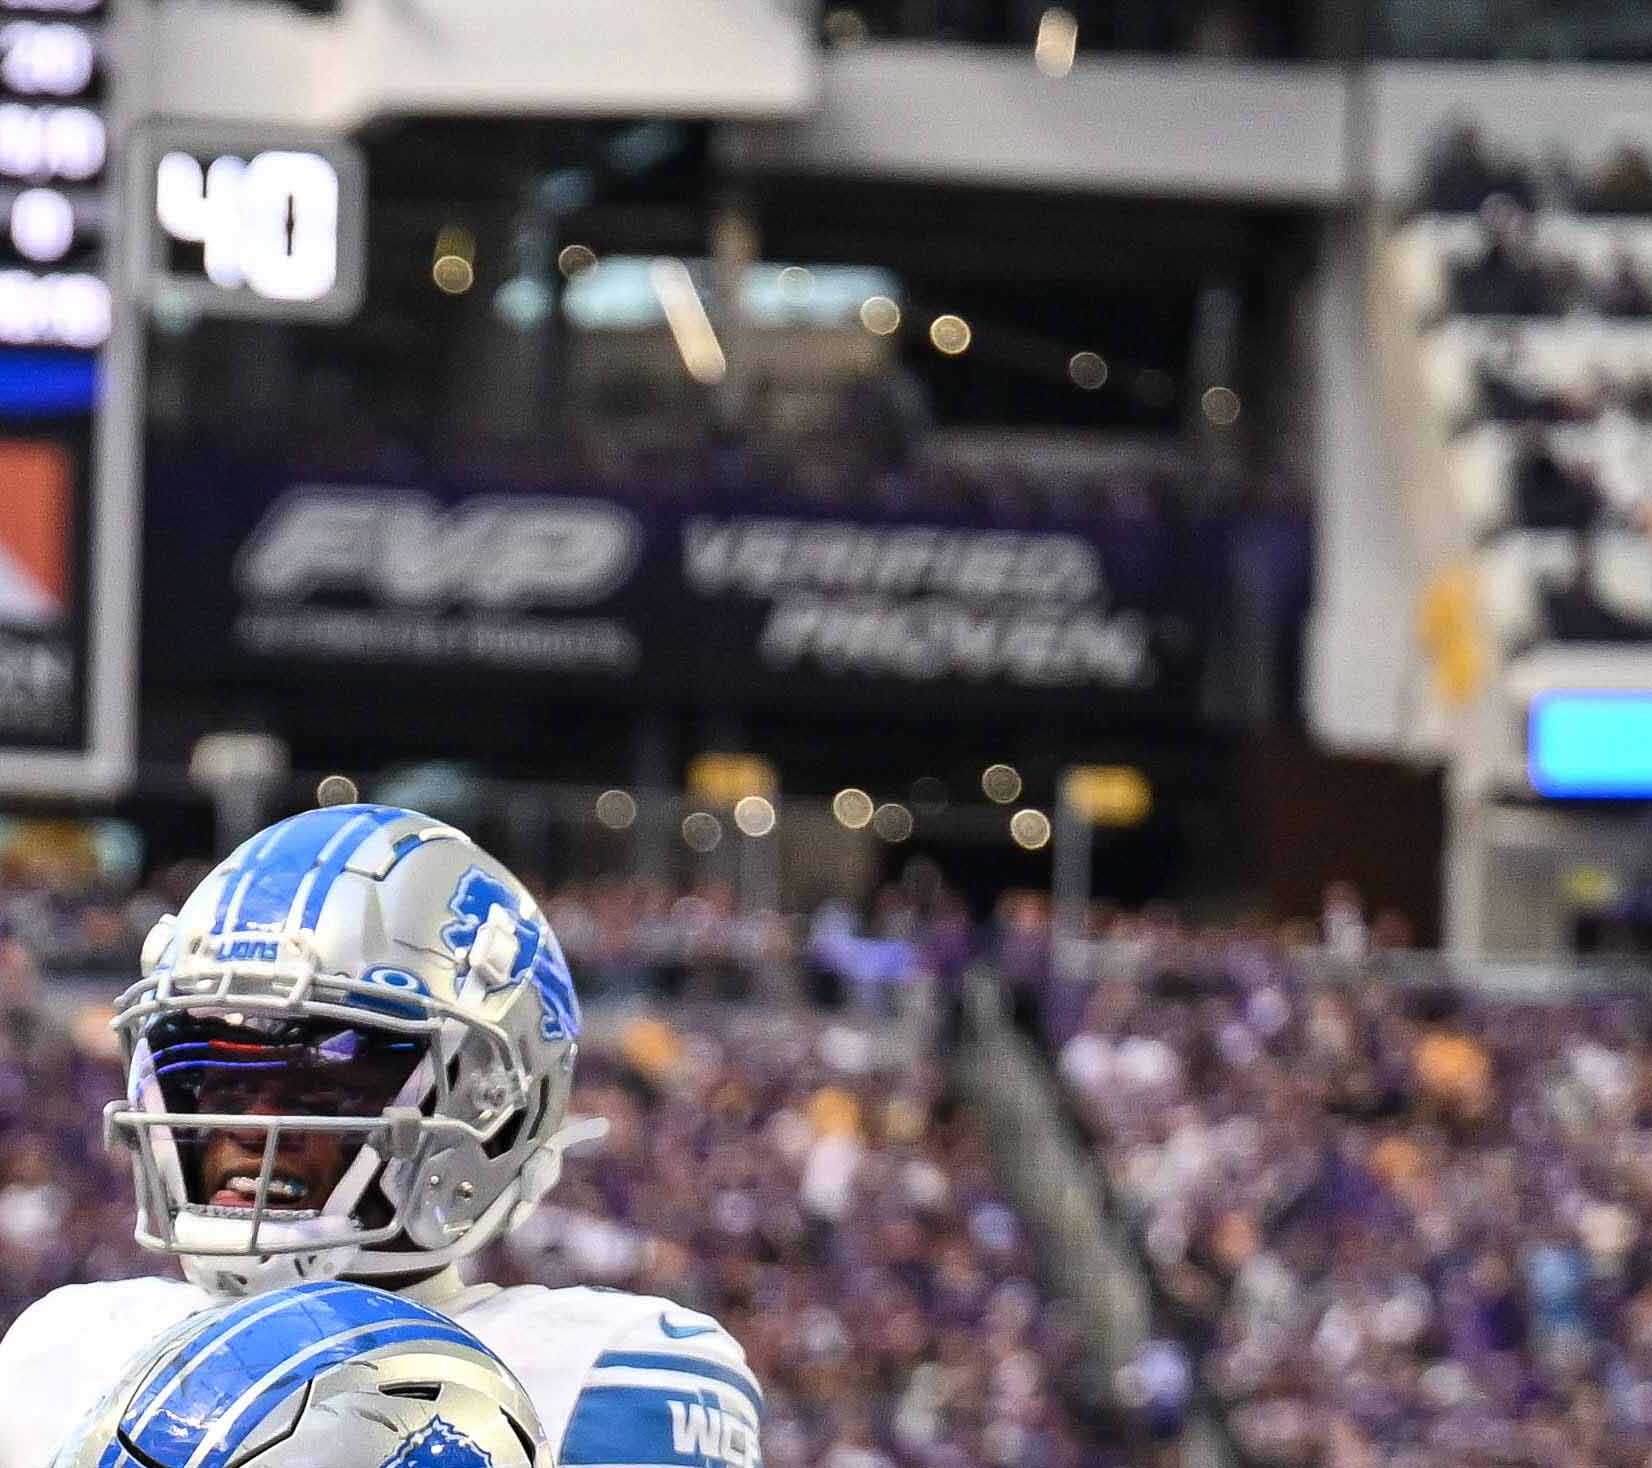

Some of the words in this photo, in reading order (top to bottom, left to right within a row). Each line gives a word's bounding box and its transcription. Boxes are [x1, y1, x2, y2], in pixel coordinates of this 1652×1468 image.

[156, 150, 339, 301] 40
[233, 485, 643, 605] FVP
[683, 515, 1101, 602] VERIFIED
[761, 592, 1156, 688] PROVEN
